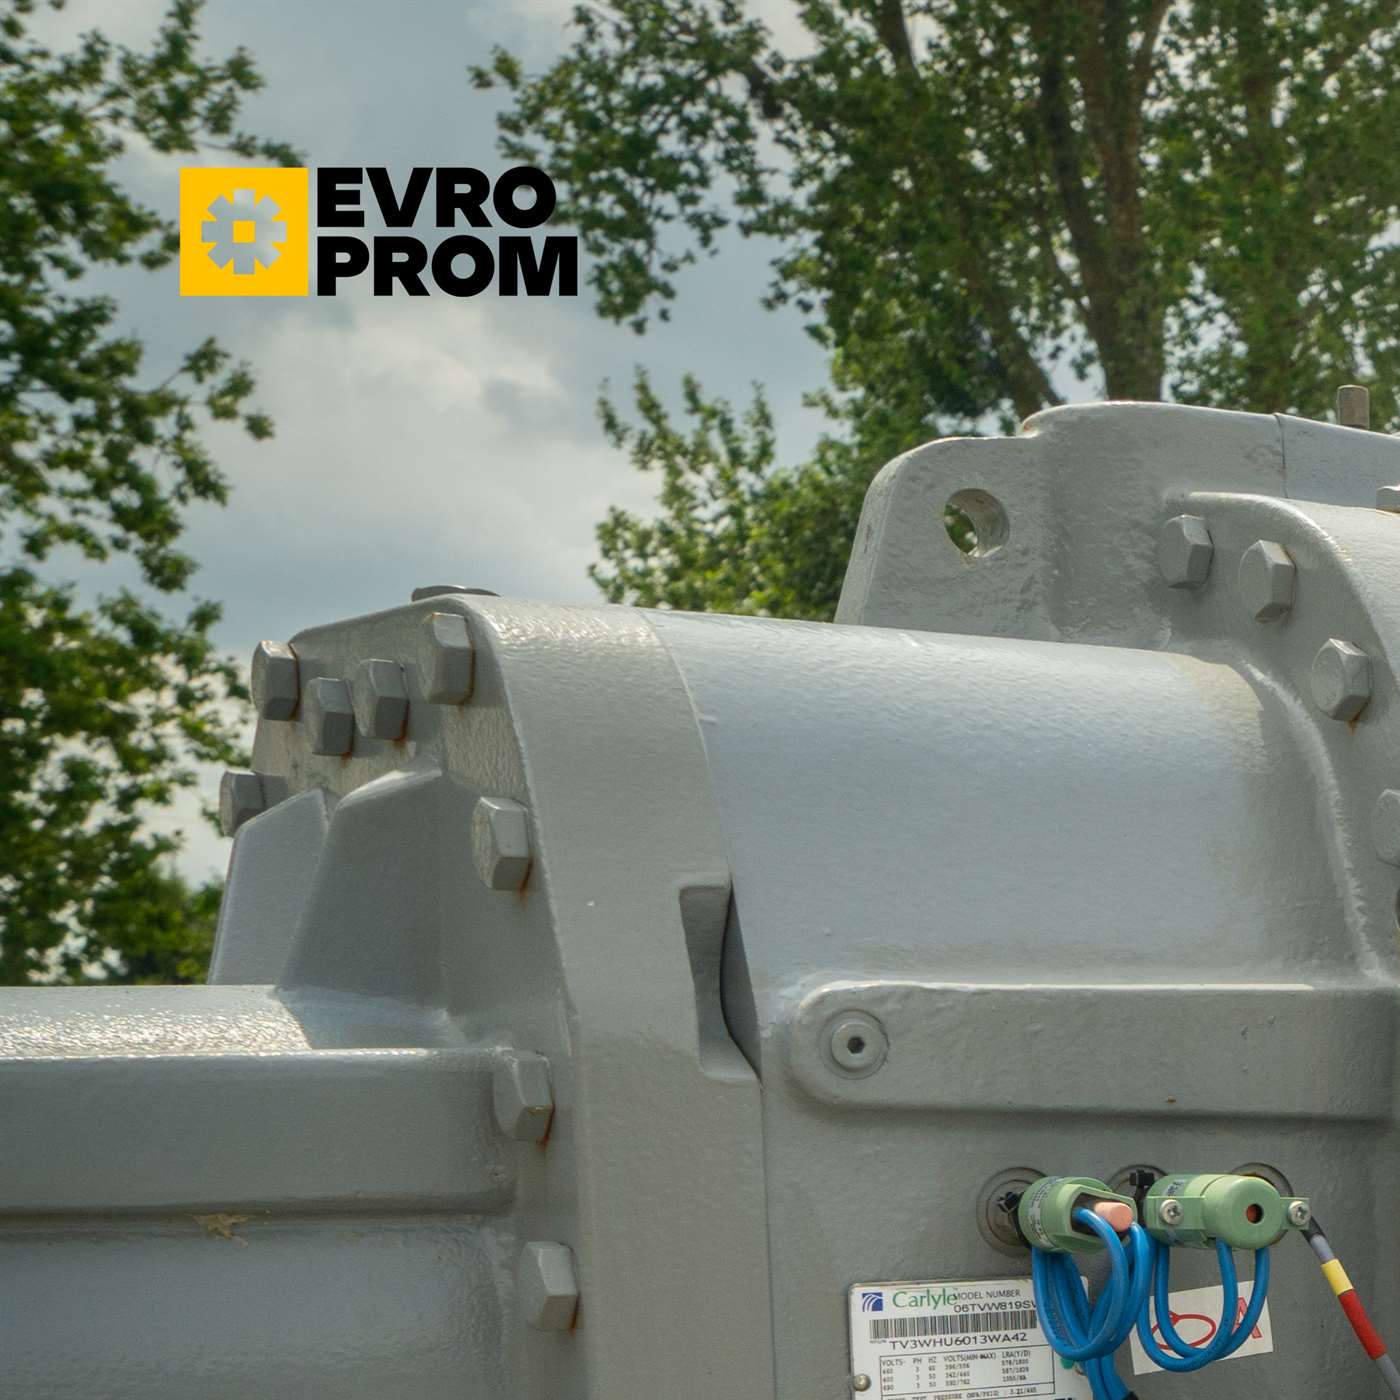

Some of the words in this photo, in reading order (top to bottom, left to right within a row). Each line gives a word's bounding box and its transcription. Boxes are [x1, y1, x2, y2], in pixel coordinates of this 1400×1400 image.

[892, 1288, 957, 1311] Carlyle
[955, 1291, 984, 1302] MODEL
[986, 1289, 1022, 1300] NUMBER
[890, 1332, 1028, 1350] TV3WHU6013WA42
[912, 1357, 922, 1365] PH
[928, 1356, 937, 1365] HZ
